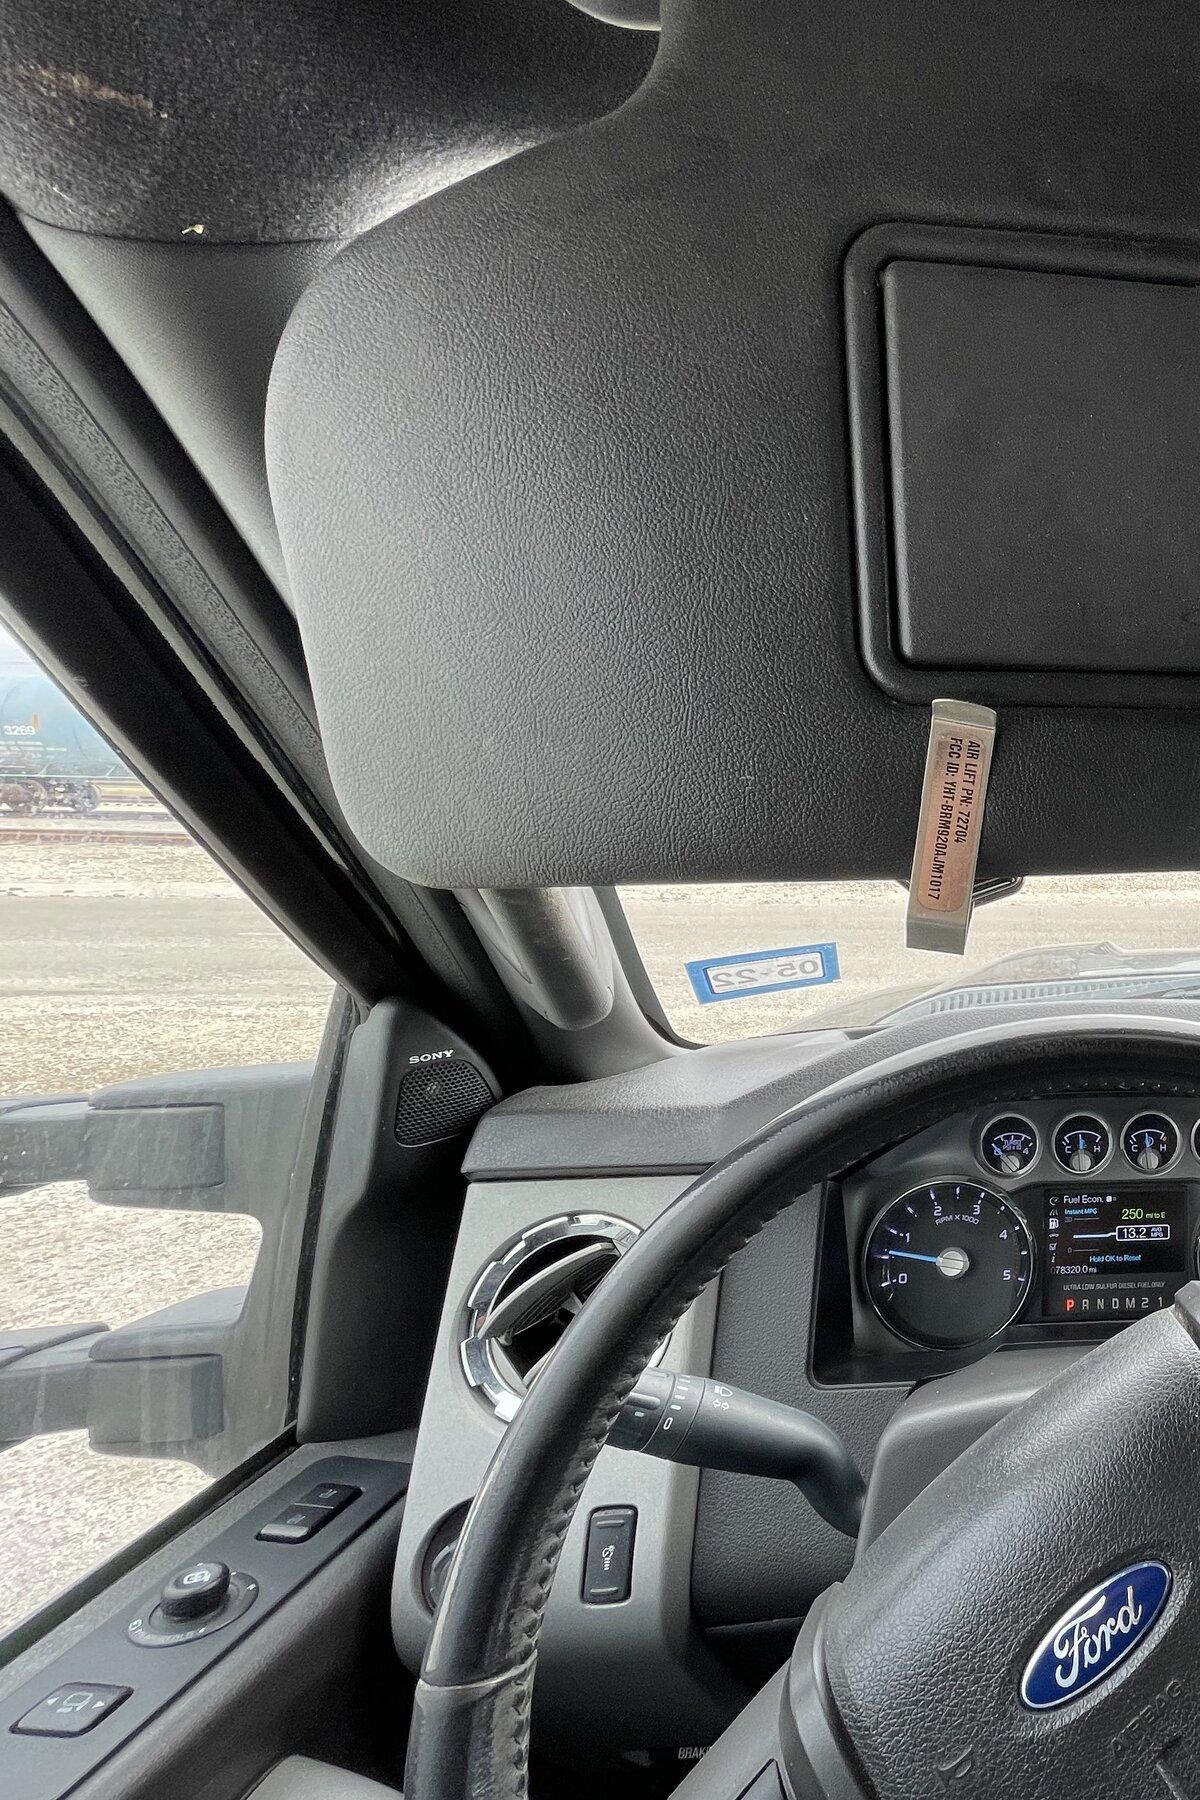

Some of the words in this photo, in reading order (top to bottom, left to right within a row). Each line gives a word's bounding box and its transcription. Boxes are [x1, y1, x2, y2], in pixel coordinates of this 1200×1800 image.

[3, 725, 36, 736] 3269
[949, 737, 963, 759] FCC
[966, 740, 981, 760] AIR
[945, 762, 960, 777] ID:
[963, 763, 978, 787] LIFT
[959, 787, 974, 807] PN:
[954, 811, 971, 844] 72704
[928, 780, 957, 900] YHT-BRM920AJM1017
[408, 1049, 454, 1064] SONY
[1064, 1145, 1072, 1154] C
[1131, 1144, 1139, 1152] C
[1063, 1196, 1081, 1204] Fuel
[1082, 1195, 1104, 1204] Econ.
[933, 1206, 942, 1216] 2
[973, 1204, 981, 1215] 3
[1121, 1208, 1144, 1219] 250
[935, 1215, 953, 1226] RPM
[962, 1215, 980, 1225] 1000
[905, 1232, 910, 1243] 1
[999, 1230, 1007, 1240] 4
[1122, 1227, 1147, 1239] 13.2
[898, 1273, 908, 1284] 0
[1003, 1270, 1011, 1281] 5
[1095, 1282, 1118, 1290] SULFUR
[1066, 1299, 1075, 1311] P
[1097, 1298, 1105, 1309] N
[1112, 1298, 1120, 1309] D
[1125, 1297, 1136, 1309] M
[1141, 1297, 1149, 1308] 2
[1158, 1297, 1163, 1307] 1
[1053, 1585, 1143, 1688] Ford
[678, 1746, 710, 1759] BRAK
